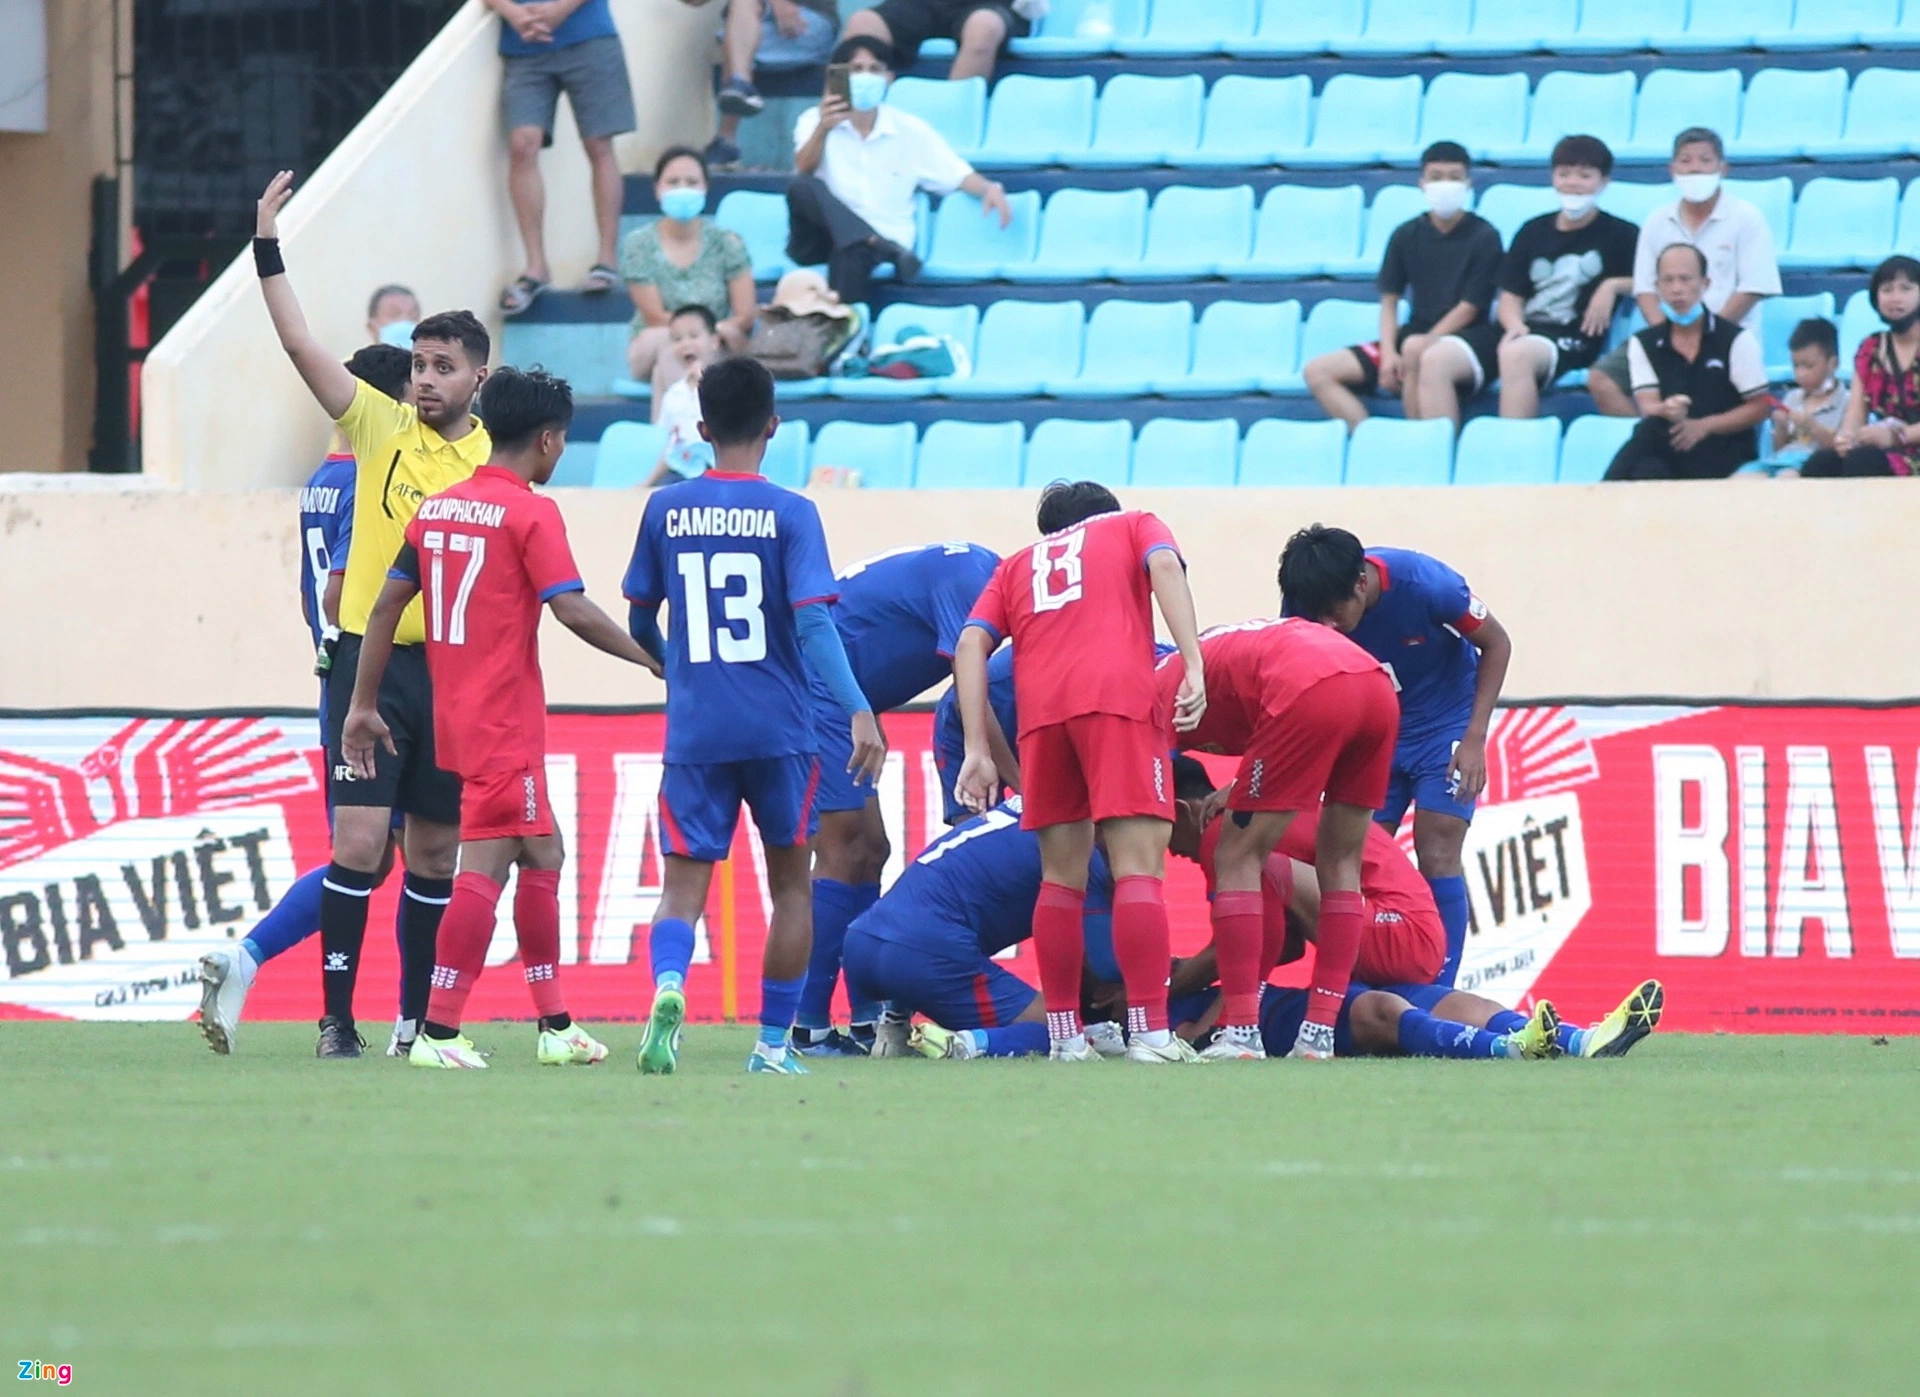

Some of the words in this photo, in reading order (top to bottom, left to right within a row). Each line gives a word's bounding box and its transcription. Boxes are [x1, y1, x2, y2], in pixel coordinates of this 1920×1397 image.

[666, 507, 777, 538] CAMBODIA
[1032, 527, 1086, 614] 8
[423, 531, 486, 645] 17
[677, 552, 767, 663] 13
[1, 872, 125, 978] BIA
[121, 827, 272, 941] VIỆT
[1476, 814, 1570, 923] VIỆT
[1651, 745, 1855, 959] BIA
